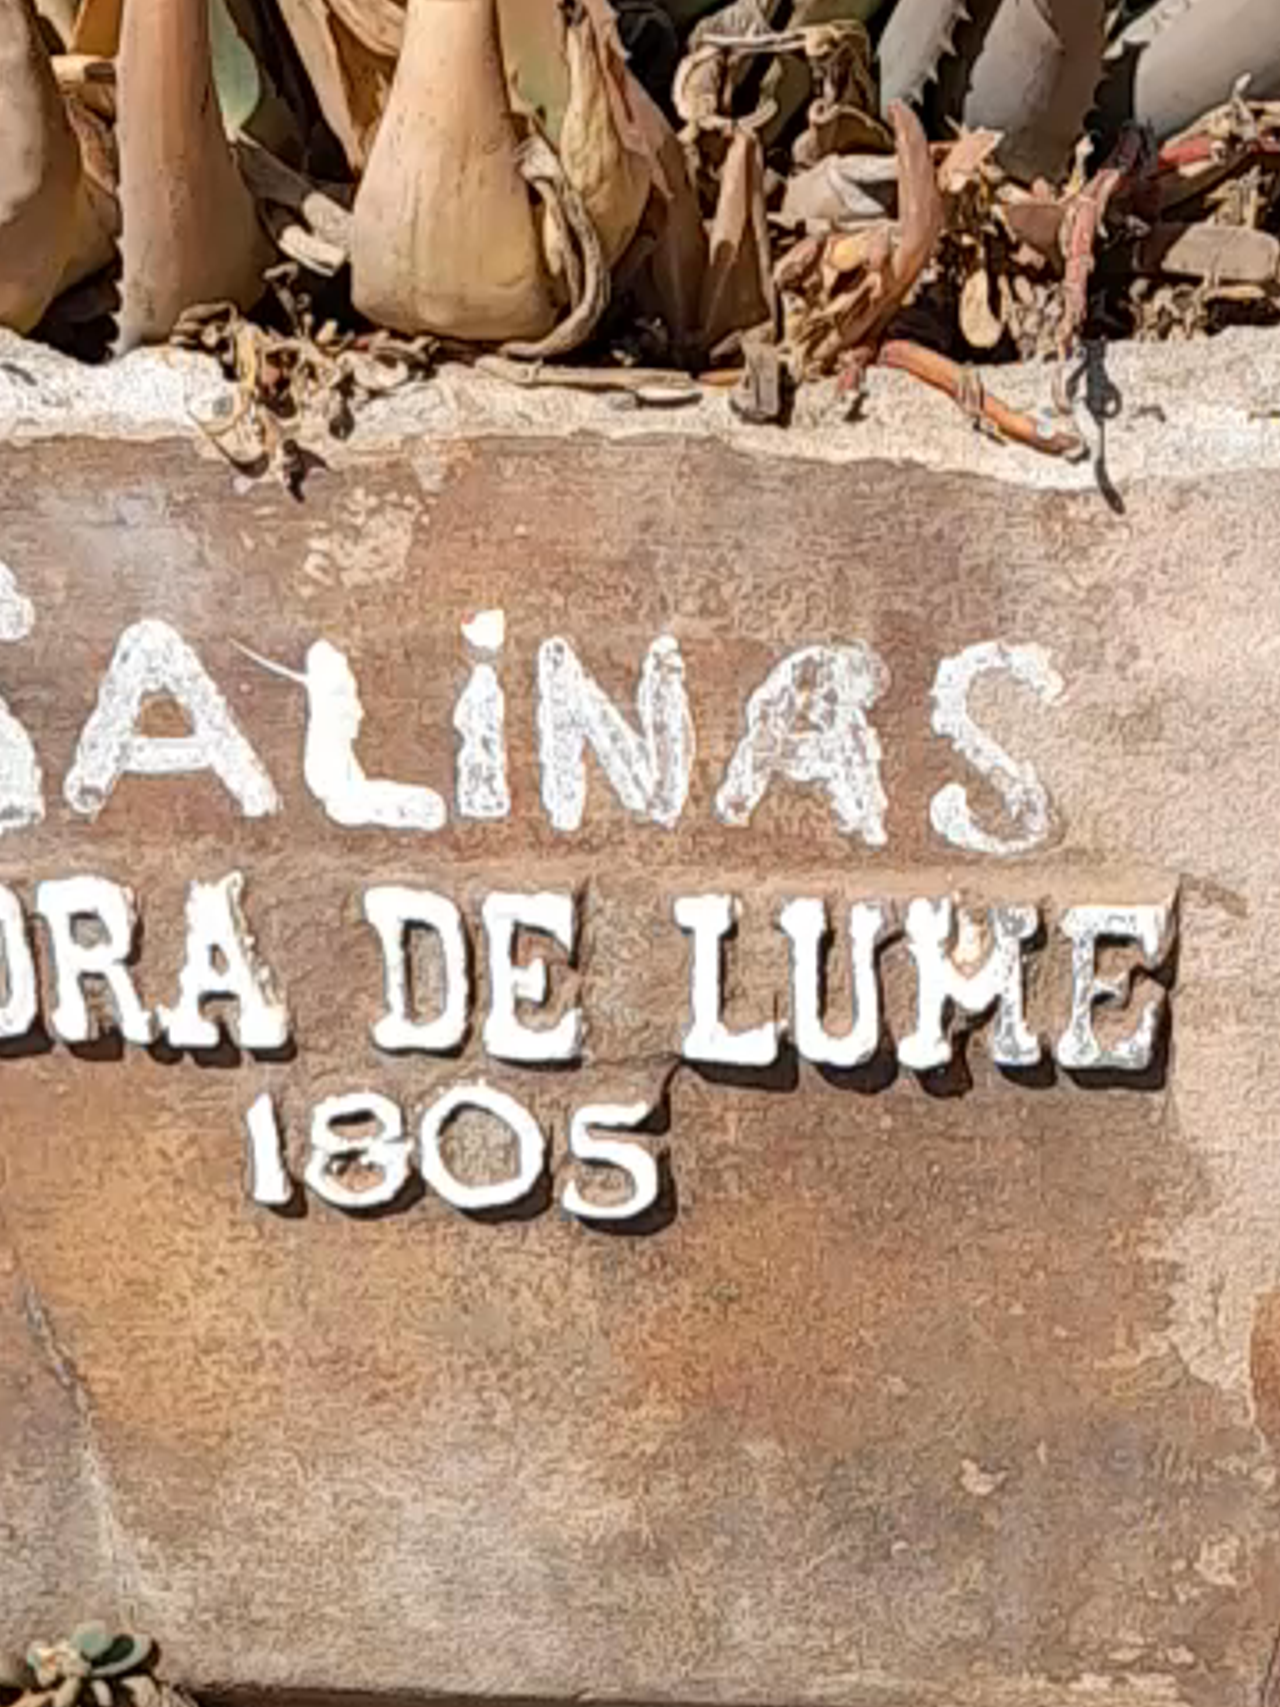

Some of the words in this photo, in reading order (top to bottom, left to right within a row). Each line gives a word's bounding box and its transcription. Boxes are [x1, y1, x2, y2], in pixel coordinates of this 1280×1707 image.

[363, 881, 588, 1063] DE
[671, 890, 1170, 1071] LUME
[243, 1081, 659, 1221] 1805
